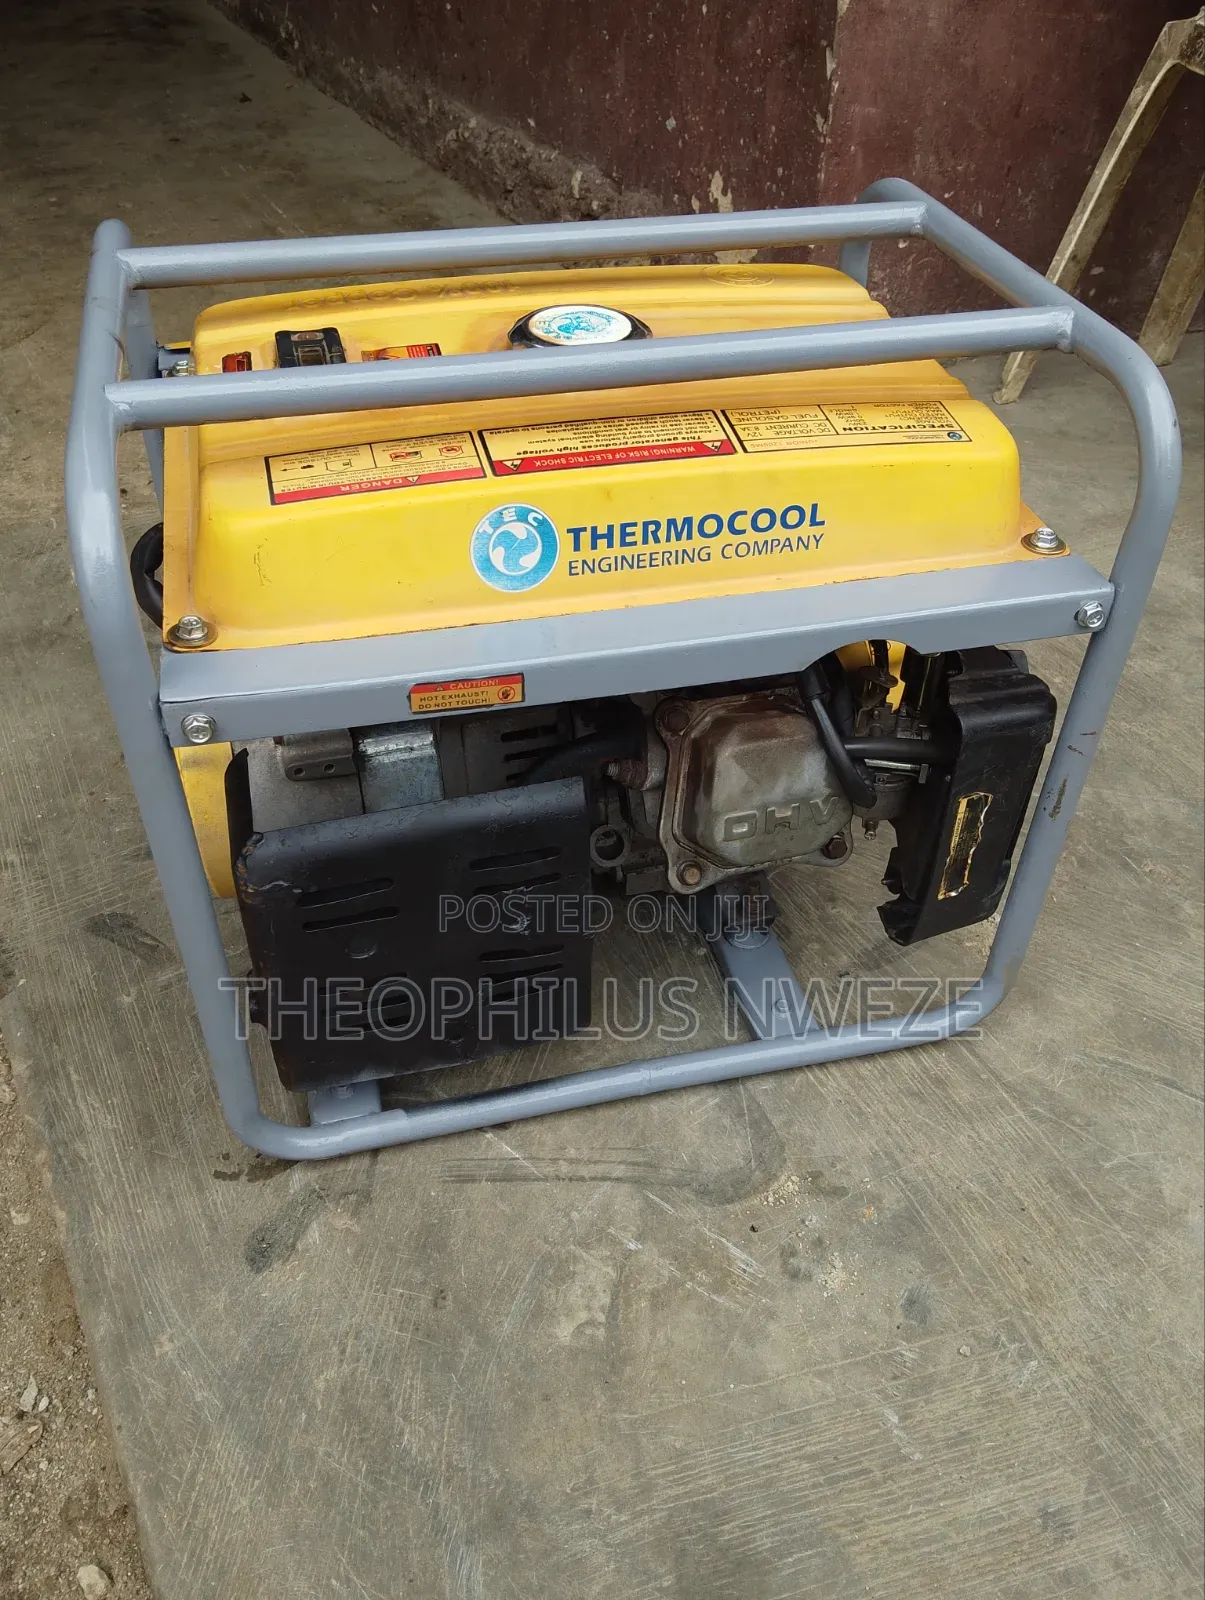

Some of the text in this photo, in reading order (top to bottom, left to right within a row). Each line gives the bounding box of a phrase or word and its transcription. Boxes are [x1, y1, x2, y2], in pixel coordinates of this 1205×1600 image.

[728, 408, 783, 417] (PETROL)
[732, 414, 791, 422] GASOLINE
[771, 428, 817, 436] VOLTAGE
[840, 422, 955, 432] SPECIFICATION
[556, 434, 595, 442] electrical
[630, 436, 679, 445] generator
[580, 440, 629, 449] produces
[514, 447, 555, 456] voltage
[649, 445, 695, 455] WARNING!
[532, 457, 567, 467] SHOCK
[566, 453, 613, 463] ELECTRIC
[339, 478, 403, 491] DANGER
[478, 506, 544, 534] TEC
[566, 502, 826, 553] THERMOCOOL
[568, 533, 825, 577] ENGINEERING COMPANY
[449, 679, 500, 690] CAUTION!
[420, 690, 489, 703] HOT EXHAUST!
[434, 701, 454, 709] NOT
[456, 697, 491, 706] TOUCH!
[722, 796, 840, 843] OHV
